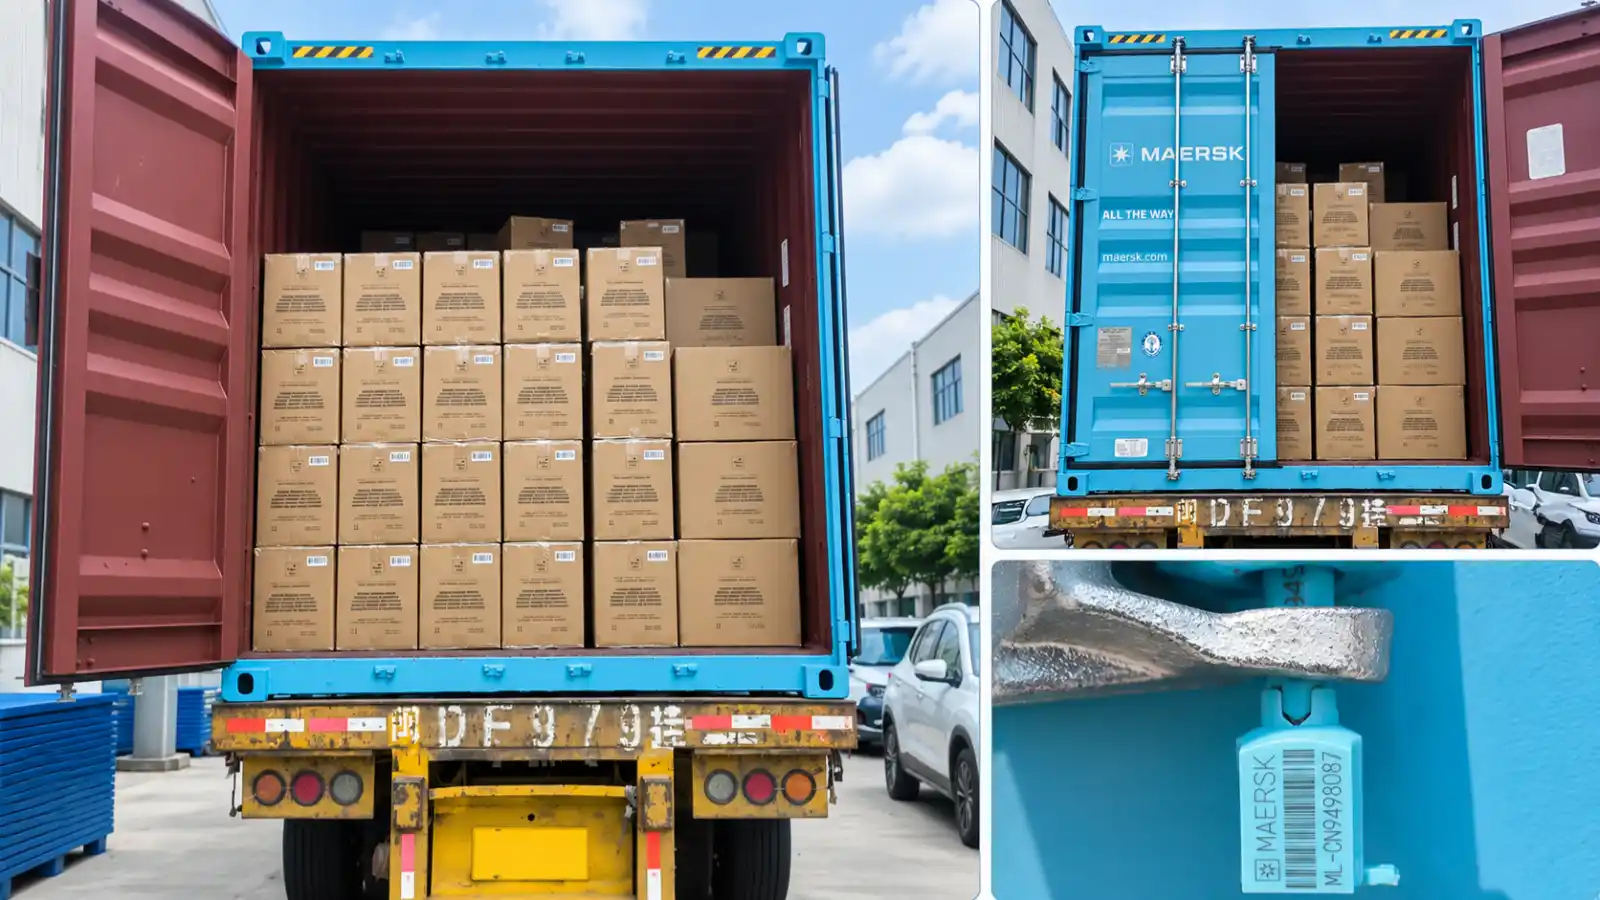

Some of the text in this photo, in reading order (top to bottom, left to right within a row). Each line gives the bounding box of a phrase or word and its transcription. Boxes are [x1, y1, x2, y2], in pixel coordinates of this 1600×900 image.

[1141, 146, 1245, 161] MAERSK
[1102, 209, 1174, 220] ALL THE WAY
[1102, 252, 1168, 262] maersk.com
[1253, 754, 1277, 852] MAERSK
[1321, 751, 1343, 886] ML-CN9498087
